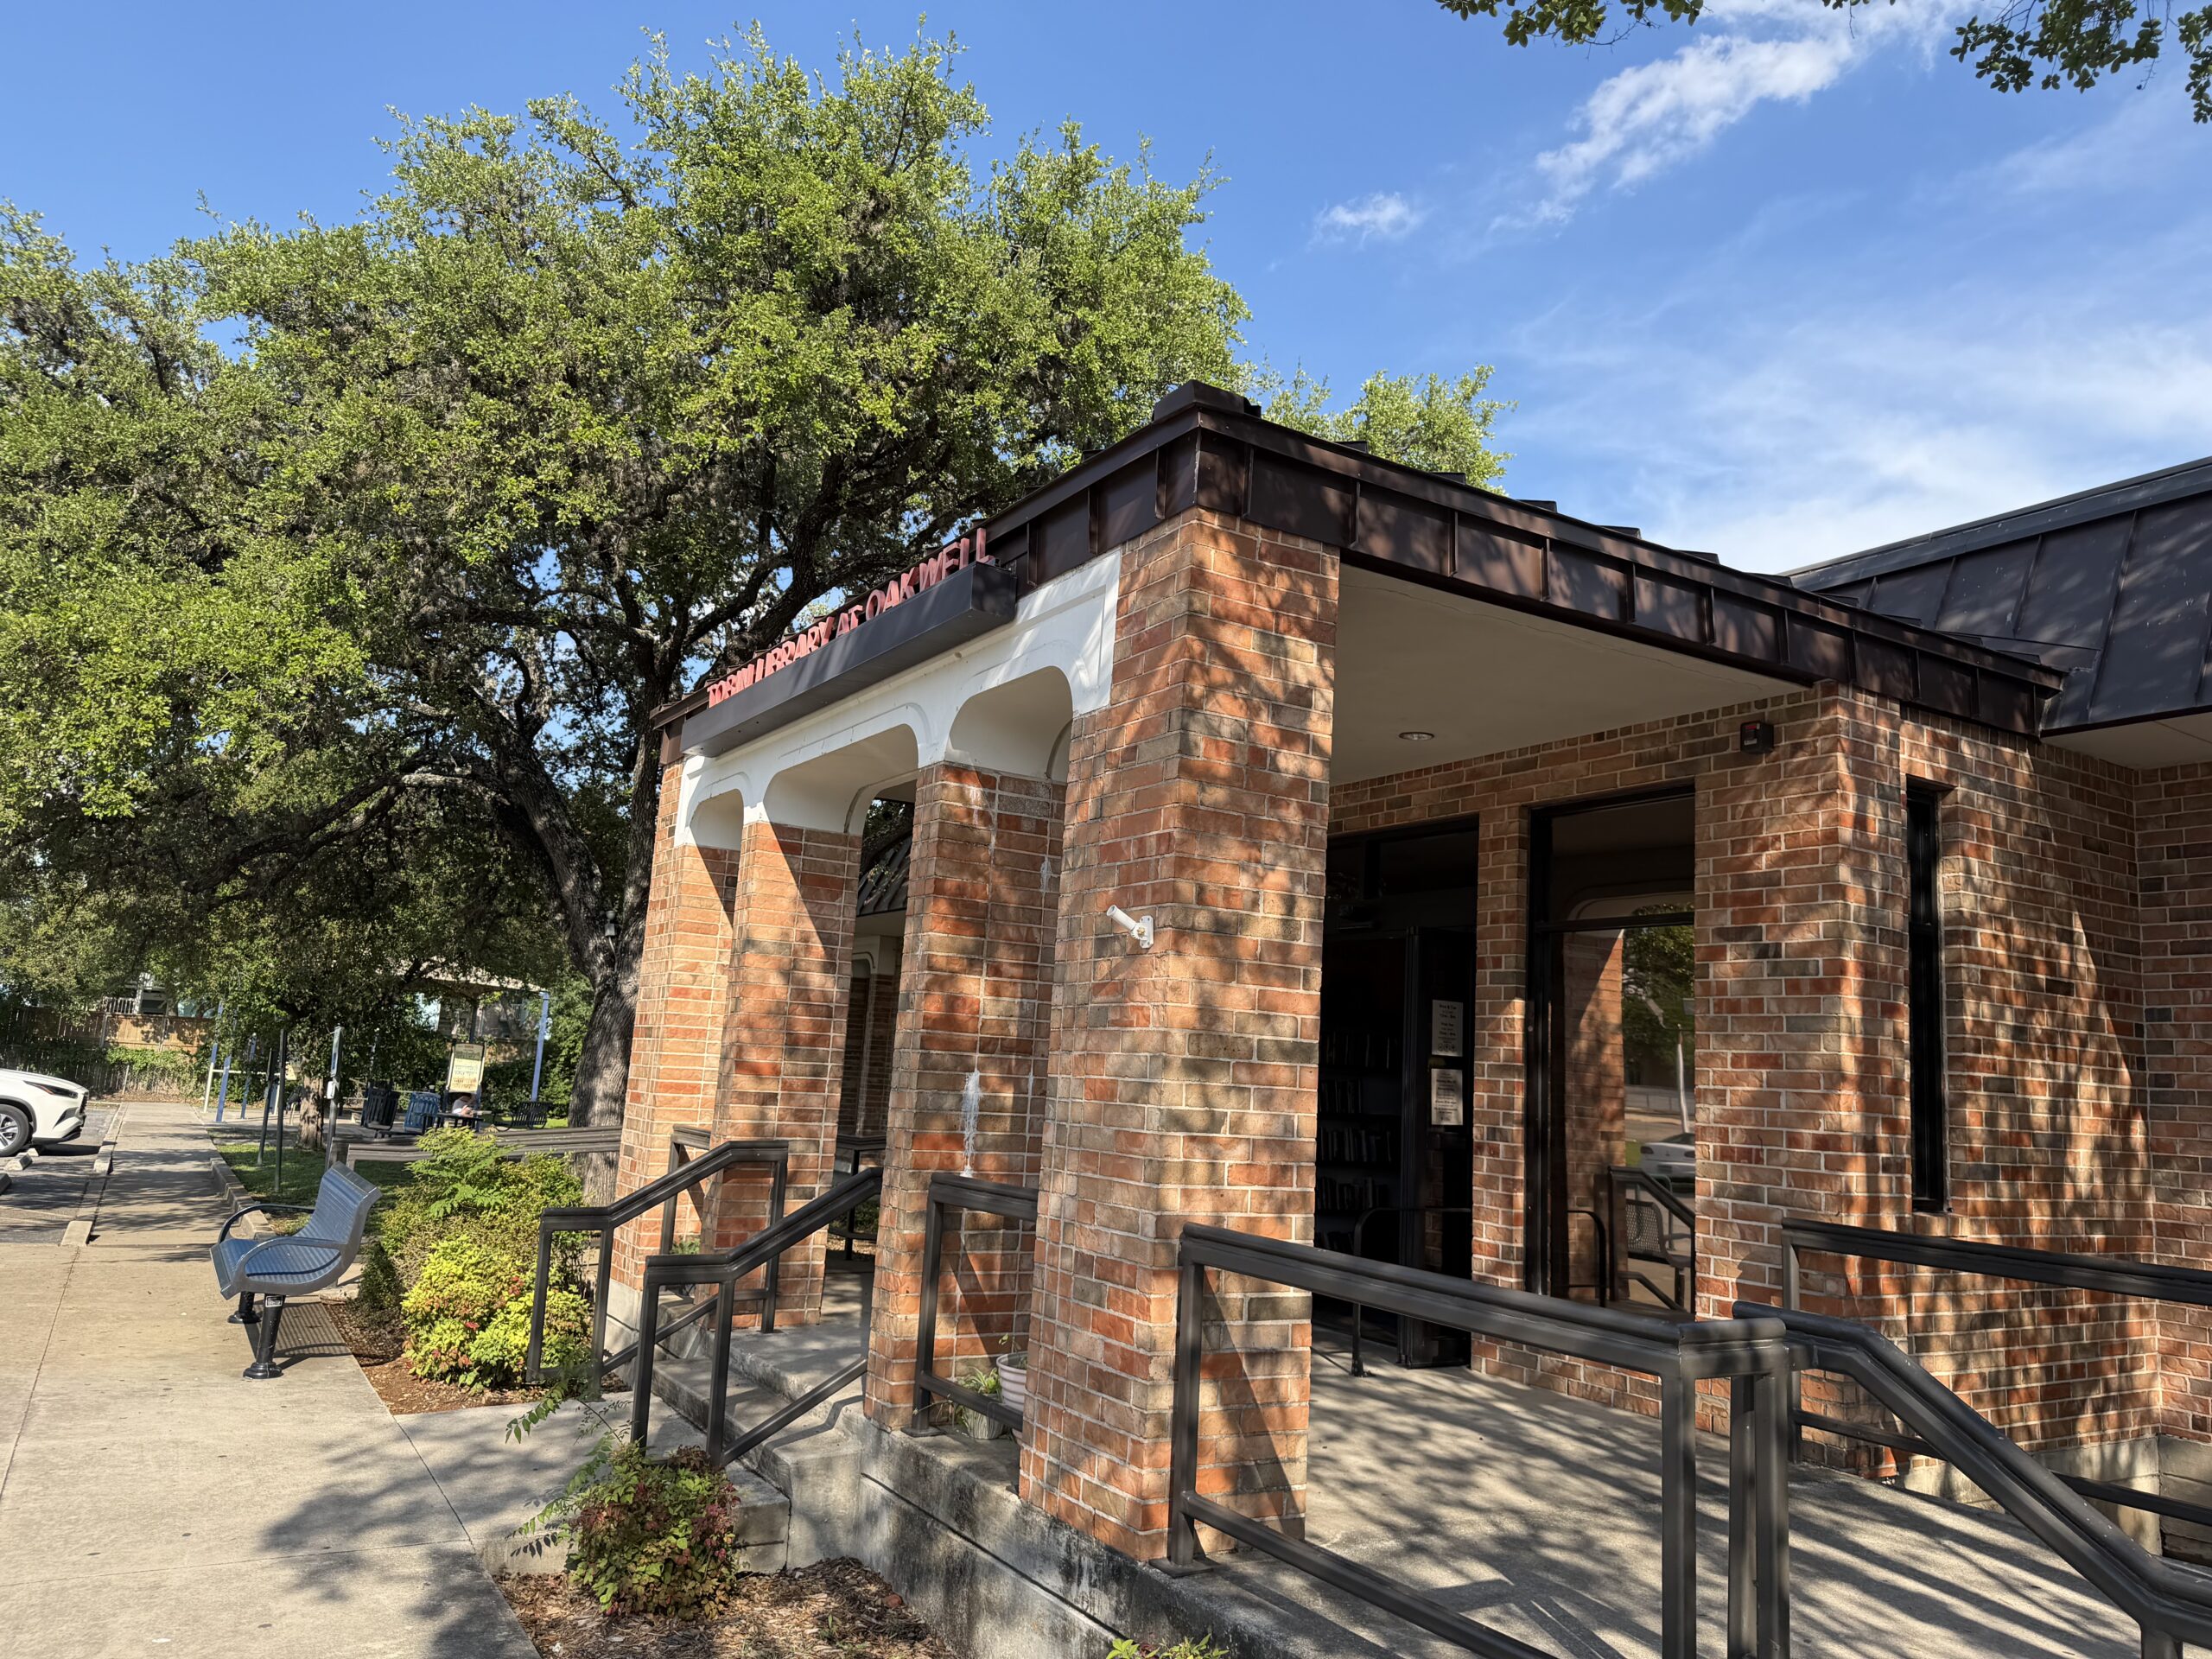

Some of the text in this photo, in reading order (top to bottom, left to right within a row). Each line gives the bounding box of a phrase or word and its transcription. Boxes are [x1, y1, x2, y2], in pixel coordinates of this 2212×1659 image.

[707, 528, 995, 708] TOBIN LIBRARY AT OAKWELL
